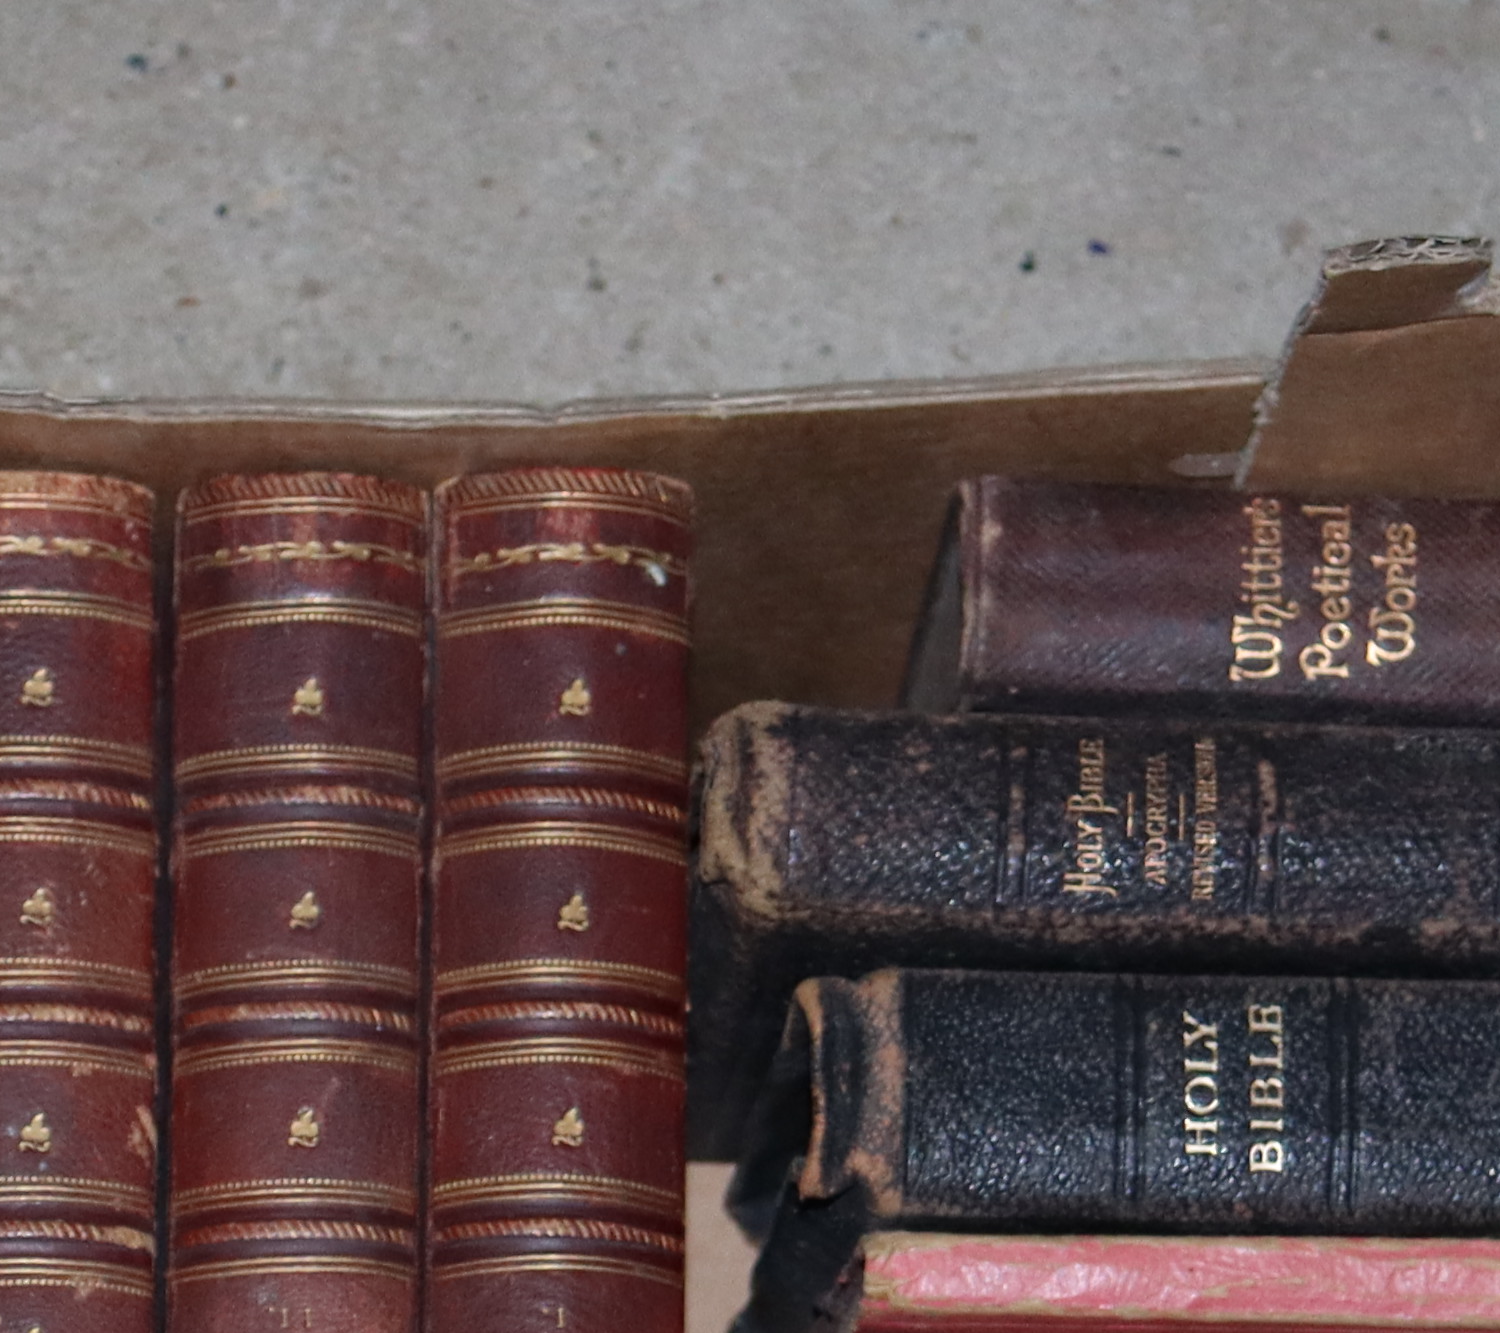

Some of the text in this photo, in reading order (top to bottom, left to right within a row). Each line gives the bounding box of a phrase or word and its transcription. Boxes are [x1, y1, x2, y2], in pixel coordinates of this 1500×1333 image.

[1299, 503, 1352, 681] Poetical
[1366, 522, 1418, 667] Works
[1062, 736, 1120, 898] HOLY BIBLE
[1183, 1009, 1219, 1156] HOLY
[1248, 1004, 1285, 1173] BIBLE
